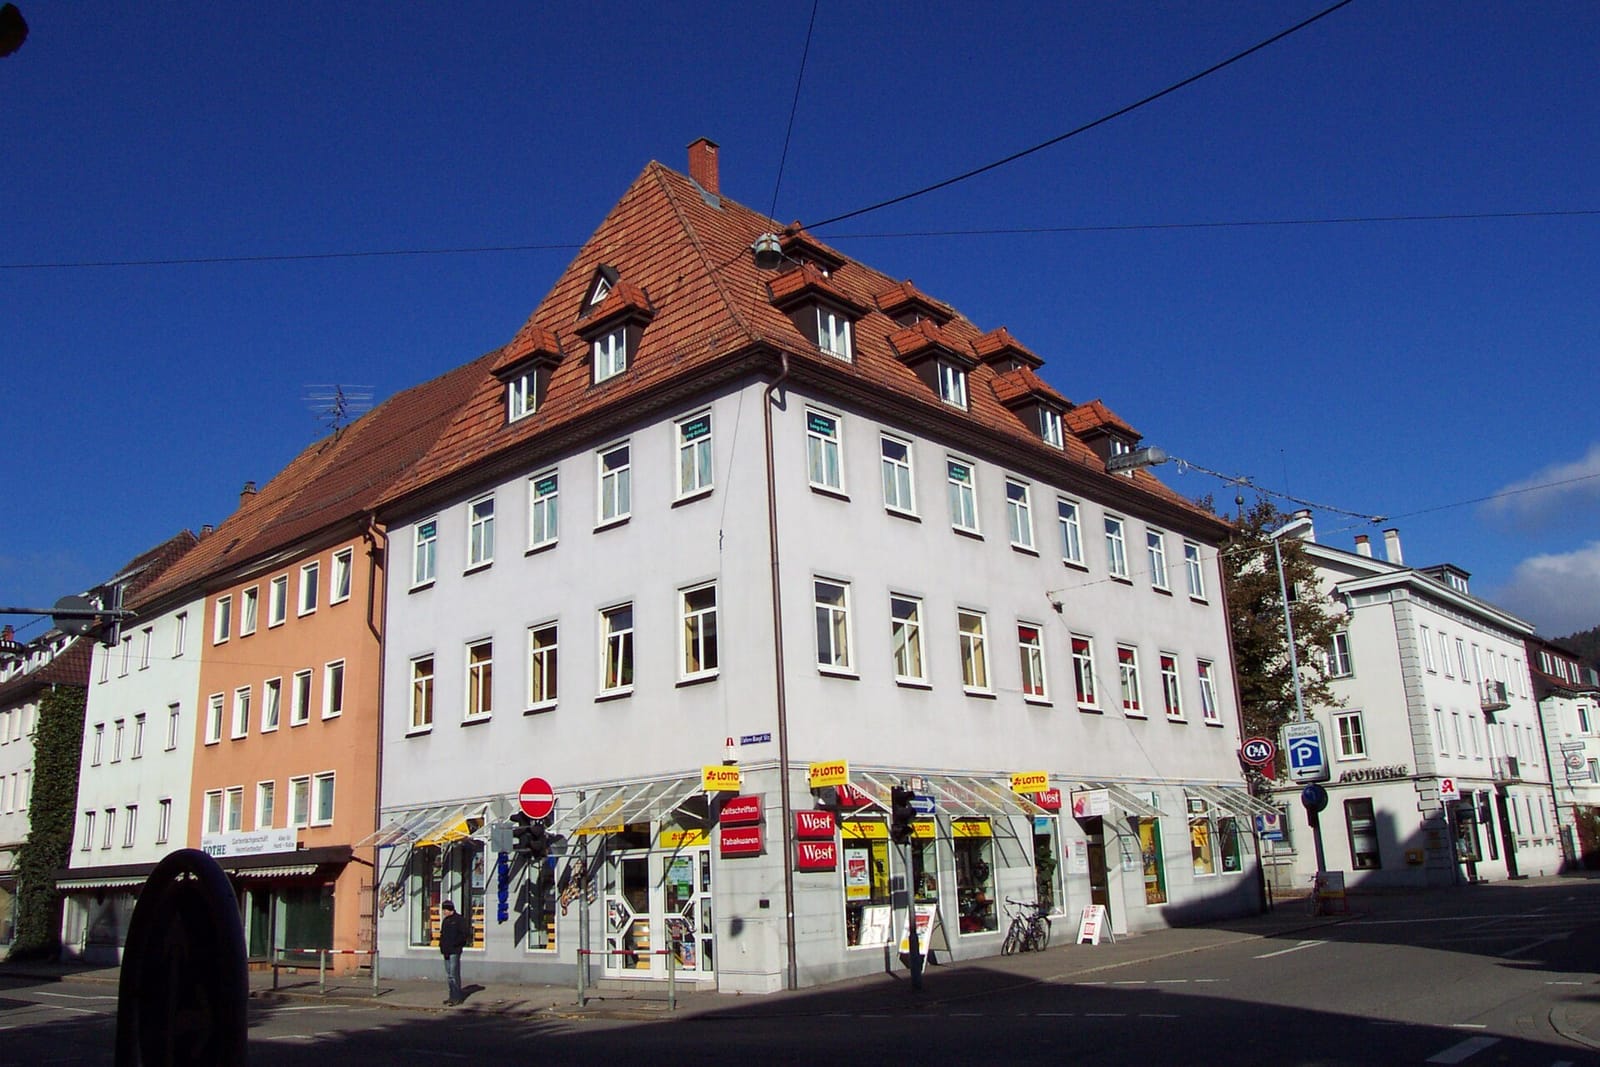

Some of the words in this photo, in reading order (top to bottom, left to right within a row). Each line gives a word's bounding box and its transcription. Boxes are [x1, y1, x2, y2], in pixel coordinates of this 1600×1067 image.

[1246, 744, 1268, 757] C&A
[1297, 746, 1312, 766] P
[717, 771, 739, 781] LOTTO
[820, 766, 845, 777] LOTTO
[1339, 764, 1409, 783] APOTHEKE
[1022, 776, 1046, 785] LOTTO
[1039, 791, 1059, 804] West
[720, 805, 757, 815] Zeitschriften
[801, 813, 832, 832] West
[722, 837, 758, 847] Tabakwaren
[803, 844, 833, 863] West
